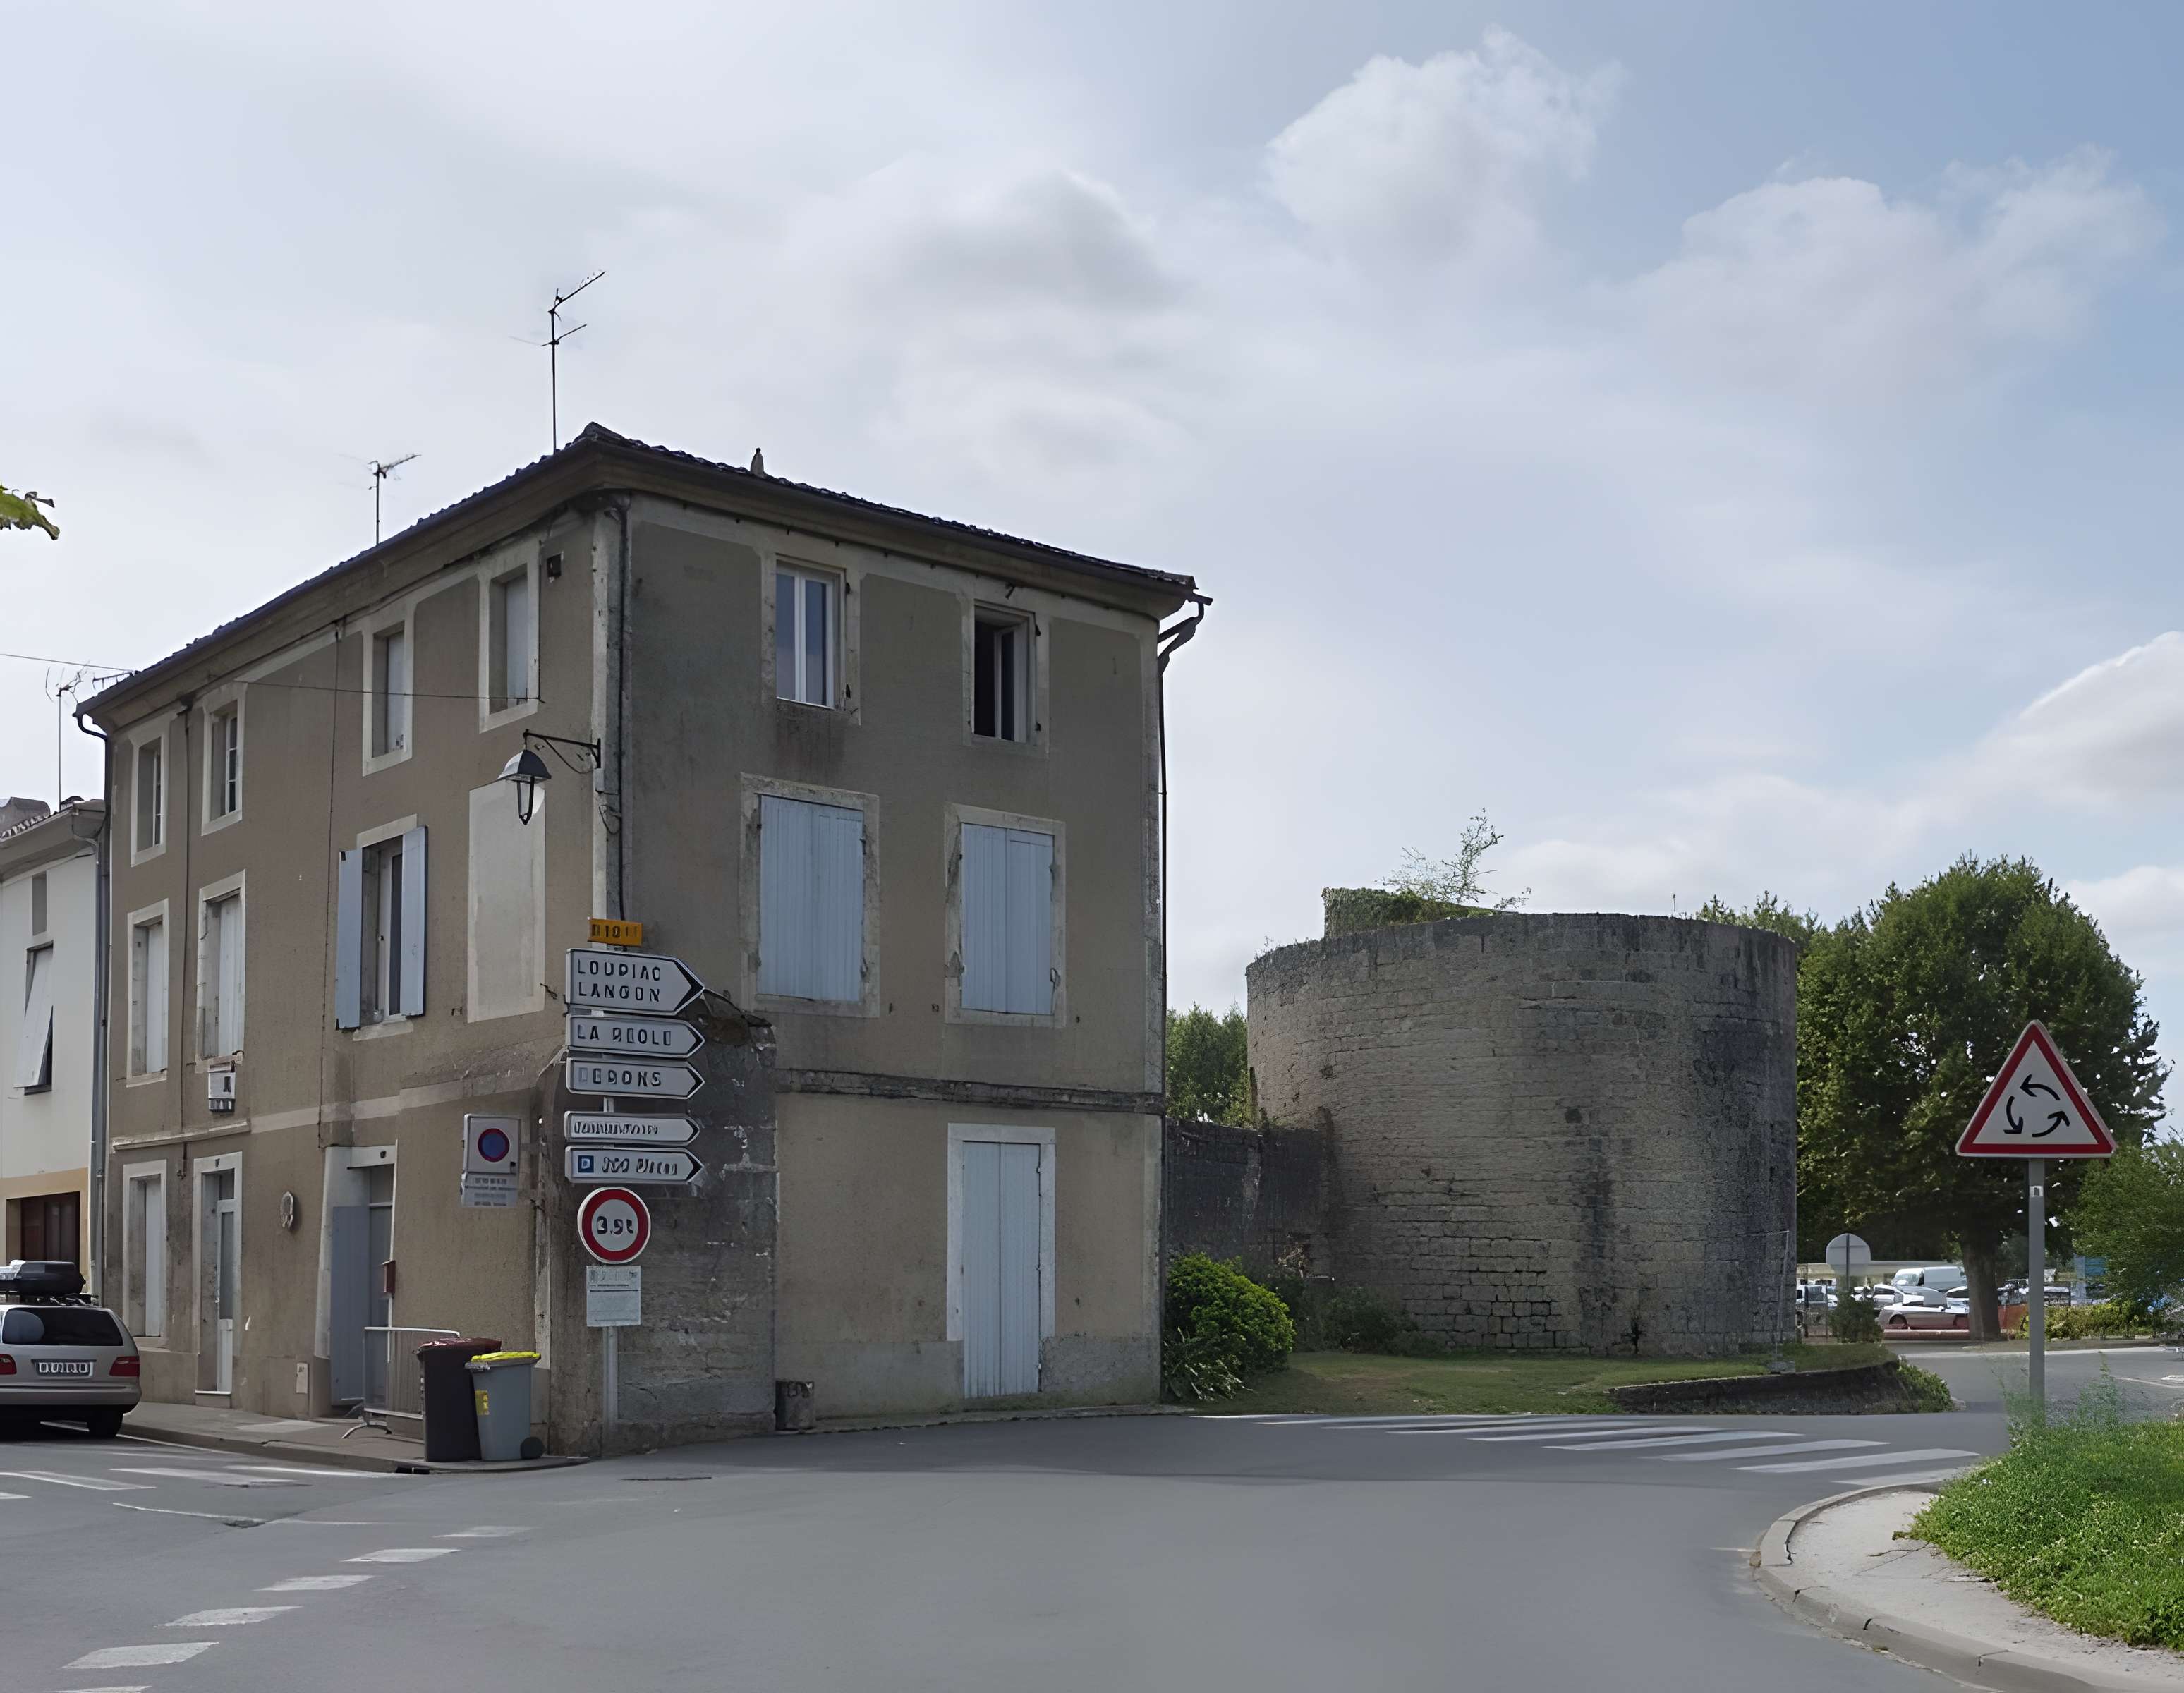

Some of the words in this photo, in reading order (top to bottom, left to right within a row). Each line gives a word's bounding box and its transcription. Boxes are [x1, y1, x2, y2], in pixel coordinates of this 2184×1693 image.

[577, 959, 661, 981] LOUPIAC
[578, 981, 660, 1002] LANGON
[577, 1024, 599, 1040] LA
